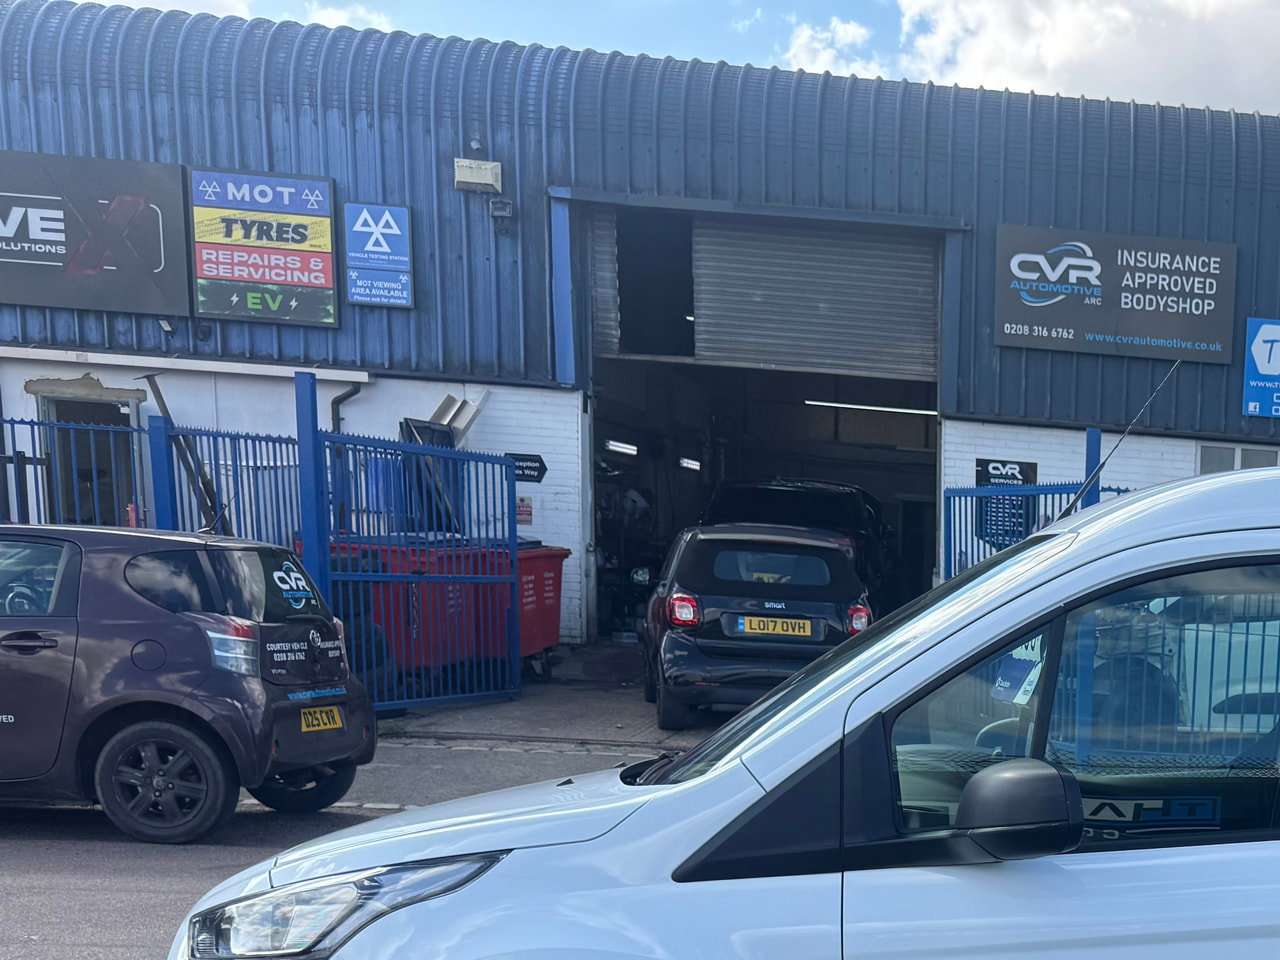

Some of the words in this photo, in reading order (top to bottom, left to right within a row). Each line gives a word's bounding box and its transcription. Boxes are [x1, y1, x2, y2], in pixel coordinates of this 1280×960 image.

[227, 182, 295, 205] MOT
[220, 217, 309, 244] TYRES
[0, 241, 66, 254] LUTIONS
[202, 248, 301, 268] REPAIRS
[310, 257, 324, 270] &
[1009, 252, 1102, 286] CVR
[1117, 249, 1222, 274] INSURANCE
[202, 263, 326, 284] SERVICING
[356, 279, 371, 287] MOT
[373, 280, 402, 289] VIEWING
[1121, 272, 1217, 295] APPROVED
[351, 287, 370, 295] AREA
[371, 288, 408, 298] AVAILABLE
[1010, 279, 1103, 296] AUTOMOTIVE
[246, 292, 284, 311] EV
[1084, 297, 1102, 306] ARC
[1120, 292, 1215, 316] BODYSHOP
[1003, 323, 1030, 336] 0208
[1032, 325, 1049, 338] 316
[1051, 328, 1075, 340] 6762
[1084, 331, 1223, 352] www.cvrautomotive.co.uk
[988, 462, 1023, 479] CVR
[273, 571, 311, 592] CVR
[748, 618, 777, 632] LO17
[781, 620, 806, 633] OVH
